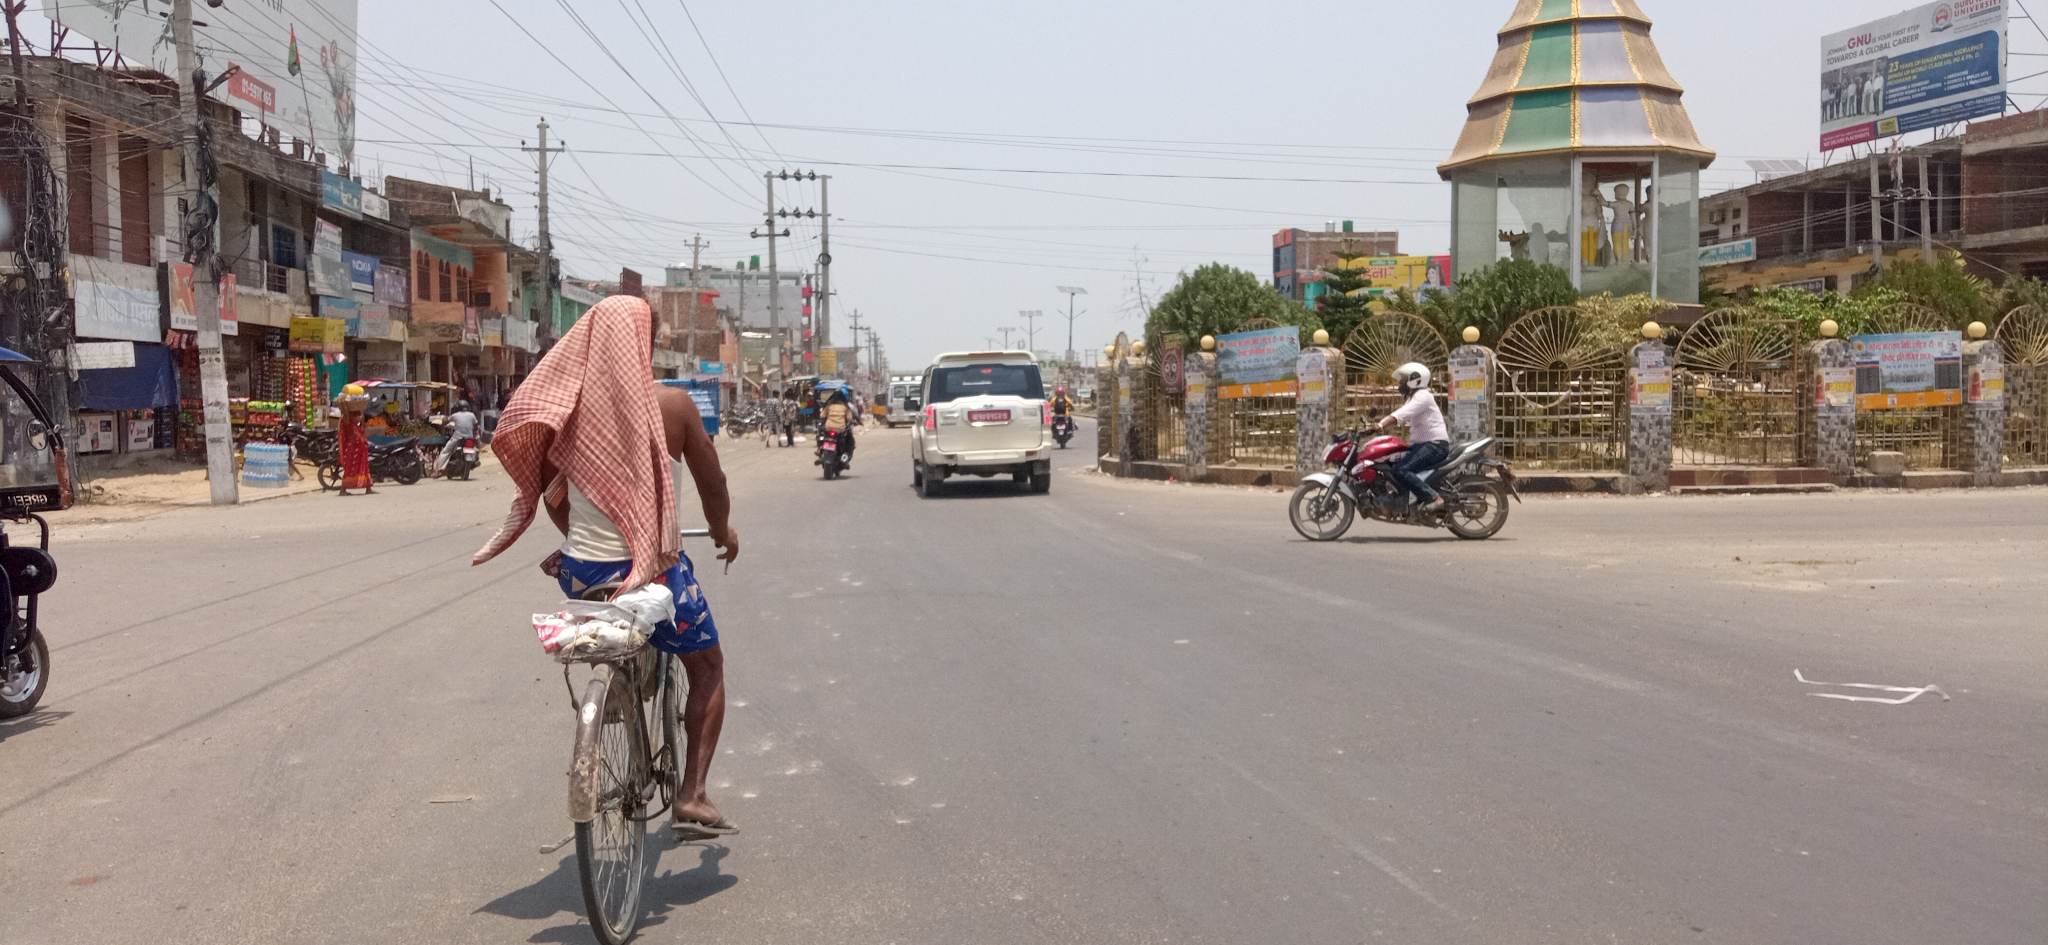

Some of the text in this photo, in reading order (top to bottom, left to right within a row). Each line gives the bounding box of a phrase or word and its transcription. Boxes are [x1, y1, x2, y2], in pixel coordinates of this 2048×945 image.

[1847, 33, 1872, 49] GNU
[1826, 51, 1857, 65] TOWARDS
[1865, 42, 1891, 56] GLOBAL
[1892, 33, 1920, 47] CAREER
[1888, 61, 1899, 73] 23
[352, 259, 371, 273] NOKIA
